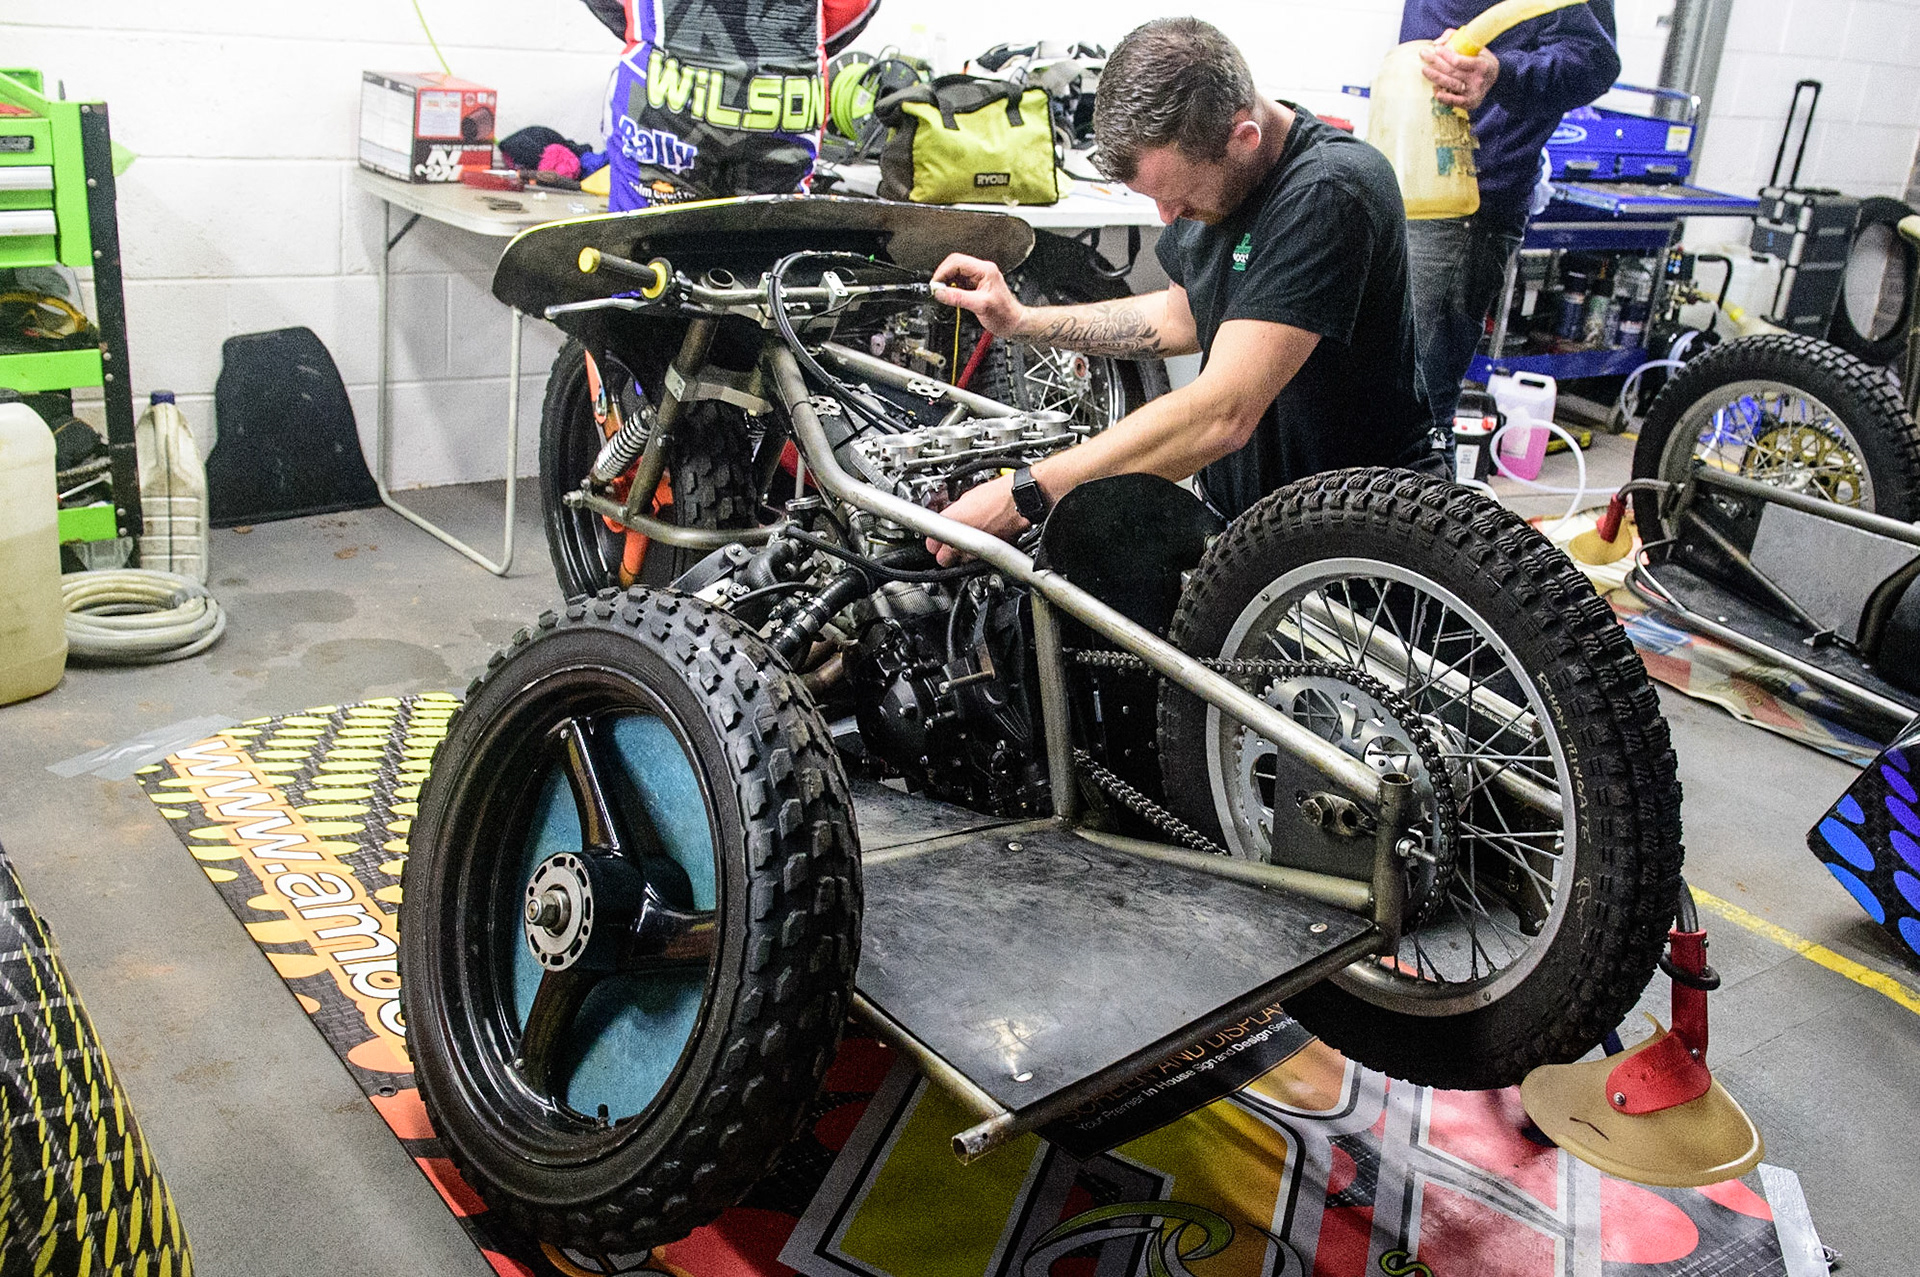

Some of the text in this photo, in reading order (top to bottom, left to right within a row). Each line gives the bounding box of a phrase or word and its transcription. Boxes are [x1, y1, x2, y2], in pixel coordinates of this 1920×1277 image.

[619, 115, 698, 176] Rally
[976, 174, 1008, 185] RYOBI
[1537, 671, 1568, 729] ROHAN
[1076, 1115, 1102, 1131] Your
[1102, 1094, 1144, 1120] Premier
[1157, 1069, 1196, 1090] House
[1194, 1057, 1217, 1072] Sign
[1216, 1047, 1235, 1063] and
[1231, 1028, 1273, 1052] Design
[1158, 1046, 1205, 1074] AND
